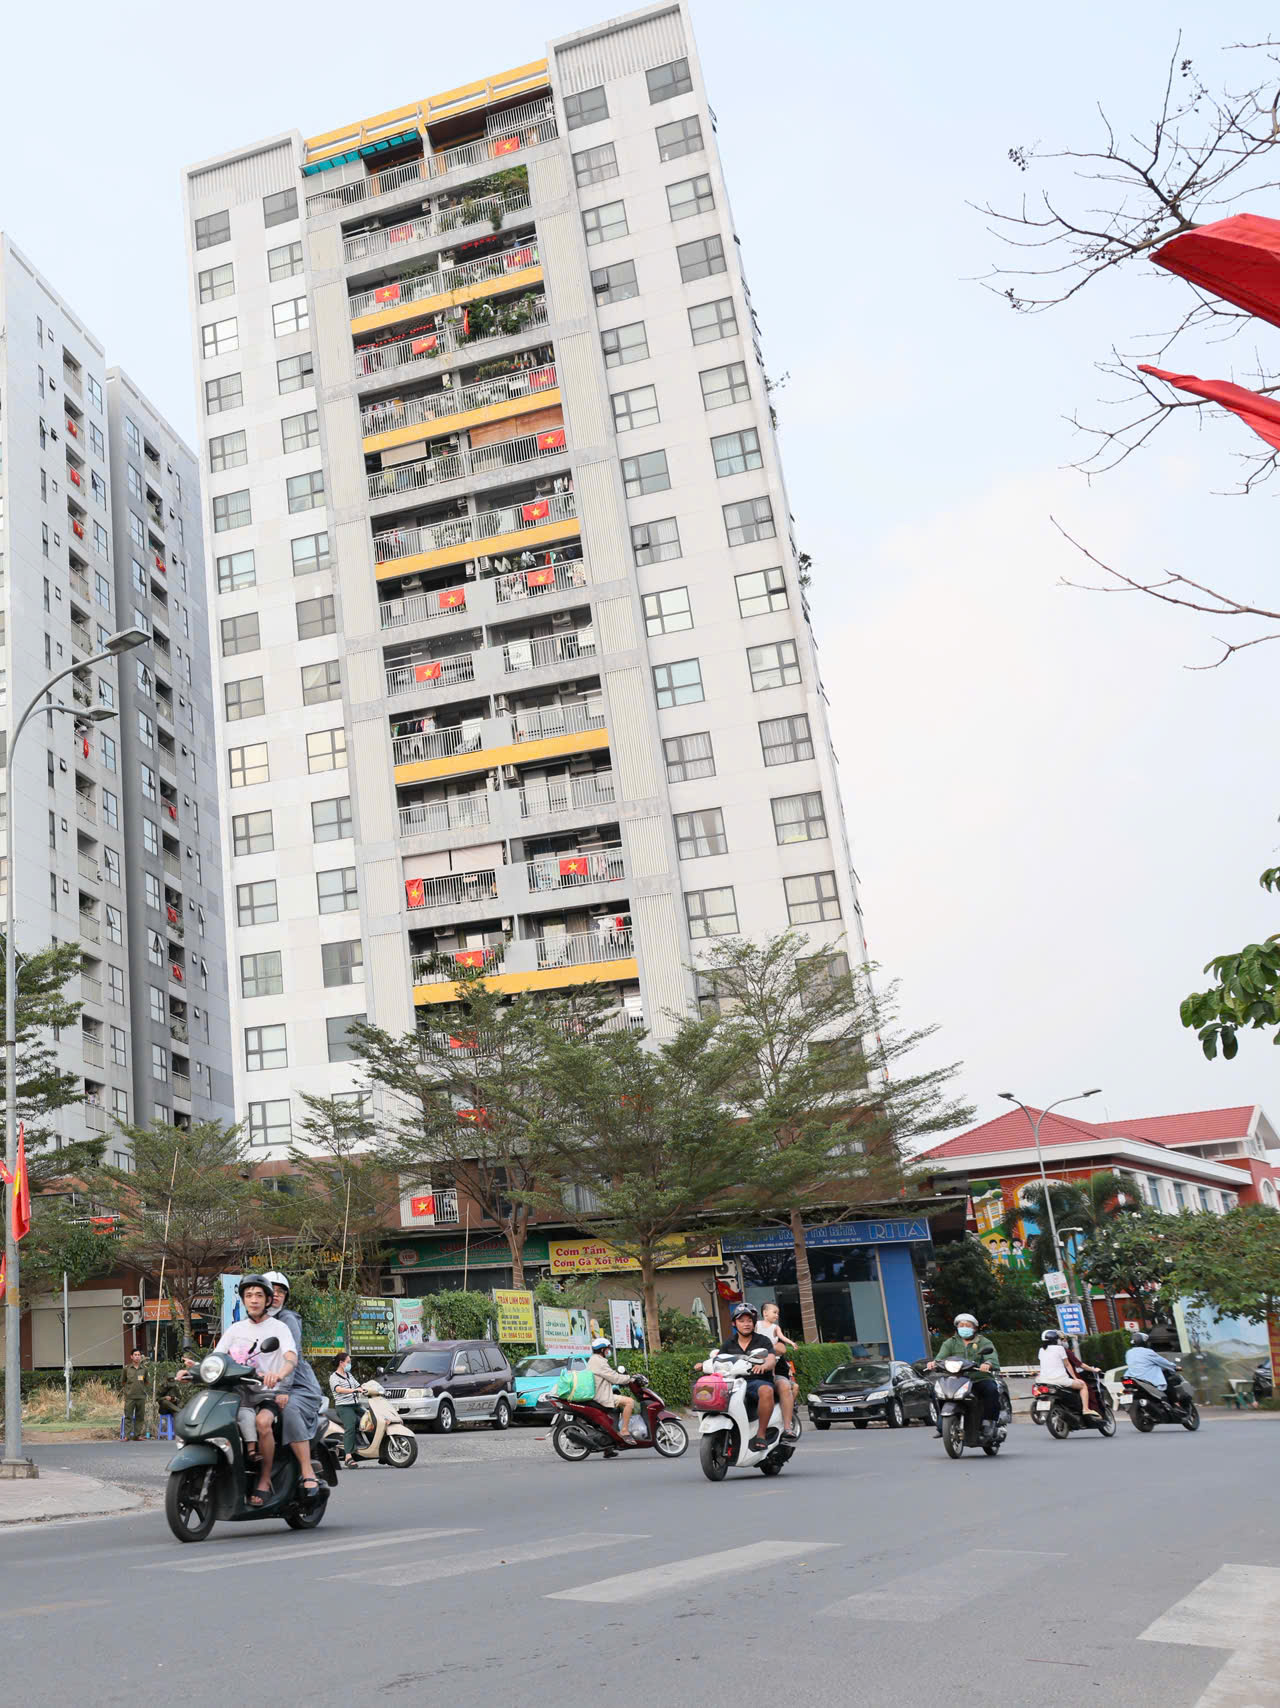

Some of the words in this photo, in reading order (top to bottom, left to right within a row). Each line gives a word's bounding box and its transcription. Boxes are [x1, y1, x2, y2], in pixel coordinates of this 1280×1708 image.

[870, 1221, 927, 1240] RITA
[556, 1248, 580, 1257] Cơm
[582, 1244, 608, 1255] Tấm
[553, 1259, 576, 1268] Cơm
[578, 1257, 592, 1267] Gà
[594, 1255, 612, 1266] Xối
